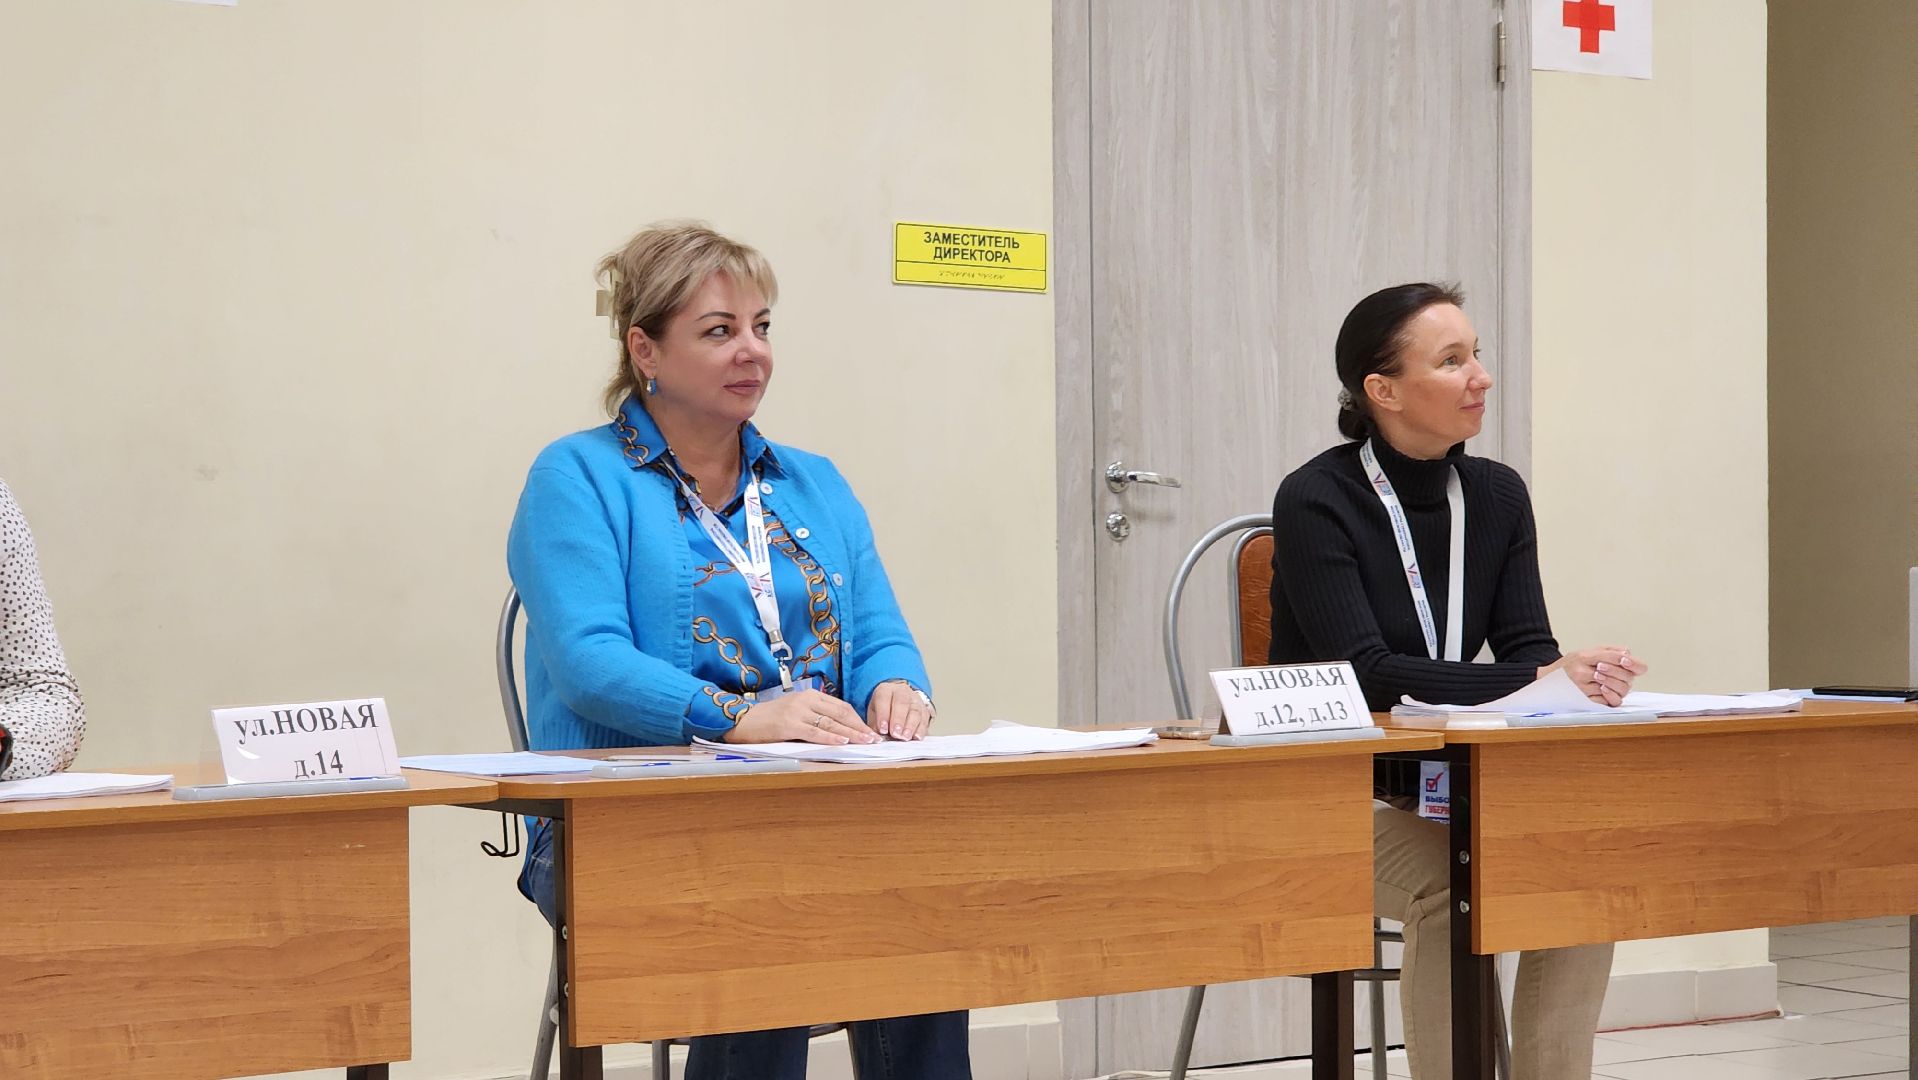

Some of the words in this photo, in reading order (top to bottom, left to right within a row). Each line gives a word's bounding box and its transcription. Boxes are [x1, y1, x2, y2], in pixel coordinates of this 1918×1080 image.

[923, 231, 1020, 249] ЗАМЕСТИТЕЛЬ
[933, 247, 1011, 263] ДИРЕКТОРА
[1228, 666, 1348, 698] ул.НОВАЯ
[234, 703, 379, 745] ул.НОВАЯ
[1255, 703, 1305, 728] д.12,
[1308, 700, 1348, 724] д.13
[294, 749, 344, 779] д.14
